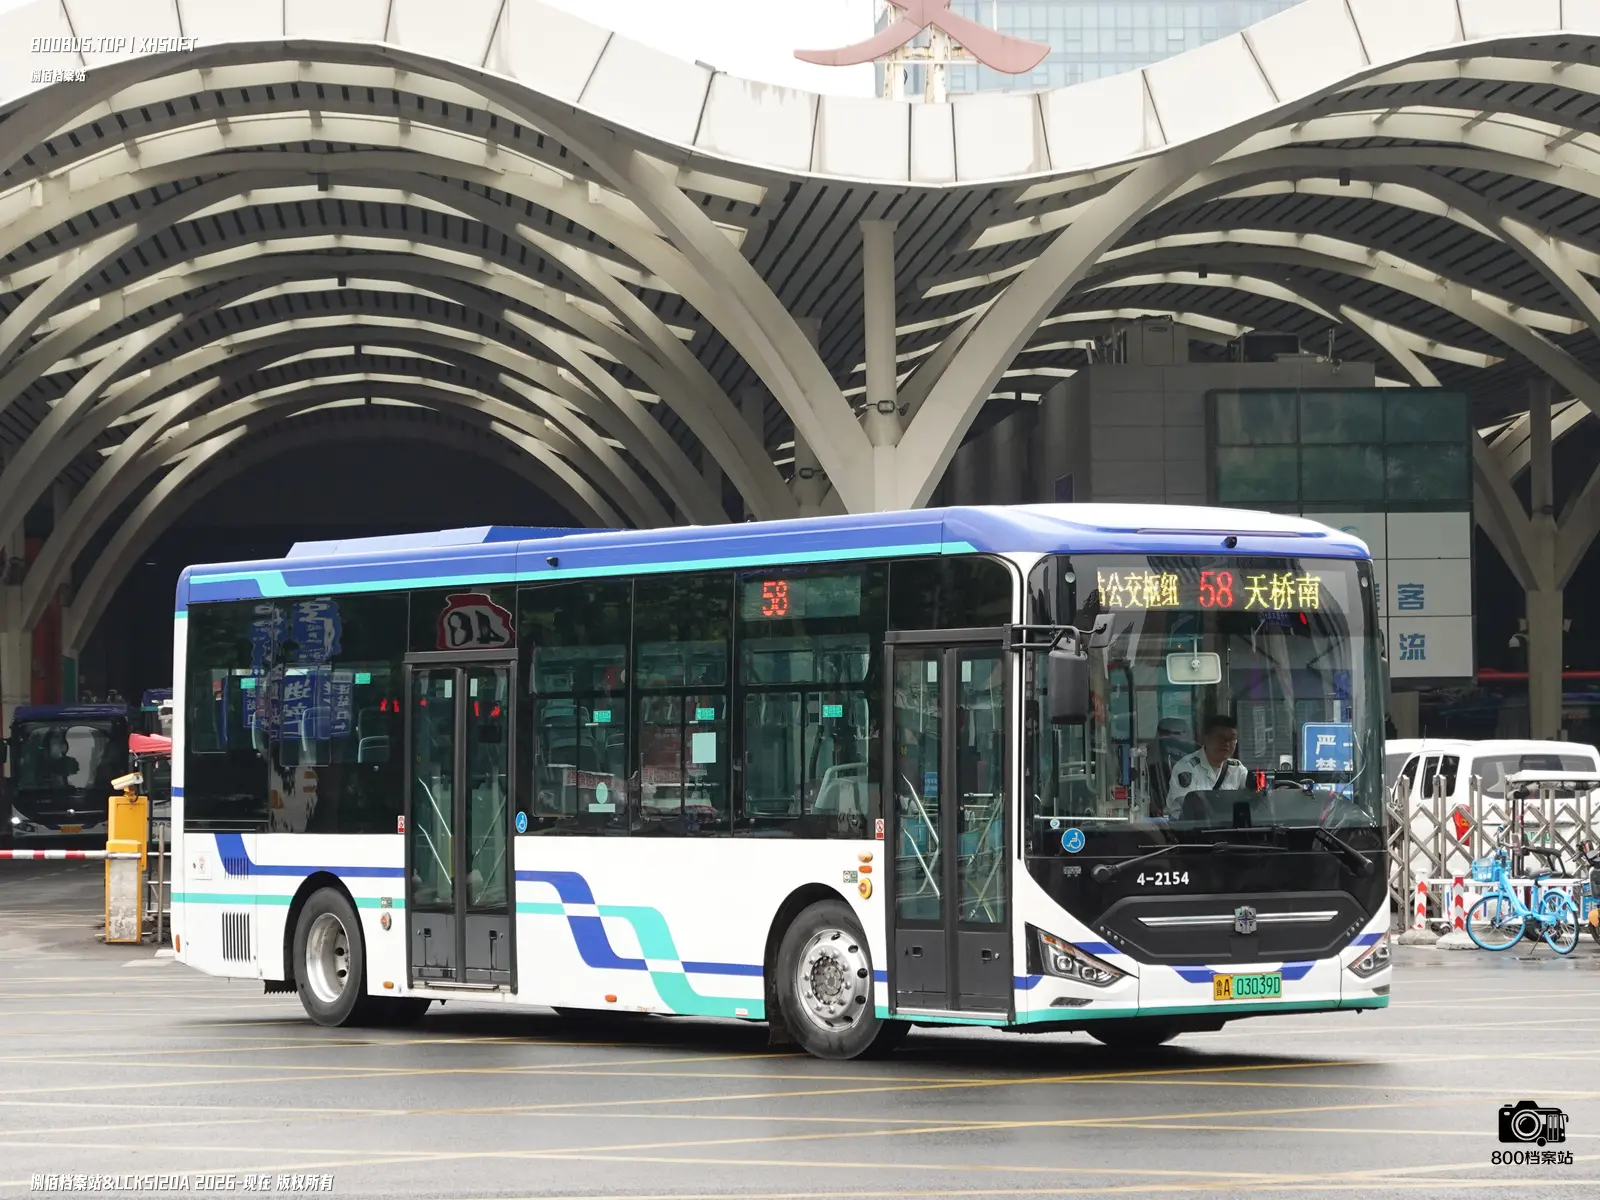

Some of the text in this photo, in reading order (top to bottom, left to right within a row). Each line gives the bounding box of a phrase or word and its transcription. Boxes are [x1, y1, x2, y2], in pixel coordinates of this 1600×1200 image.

[764, 580, 789, 617] 58
[1199, 571, 1233, 608] 58
[1244, 572, 1321, 610] 天桥南
[1136, 872, 1190, 886] 4-2154
[1236, 976, 1281, 996] 03039D
